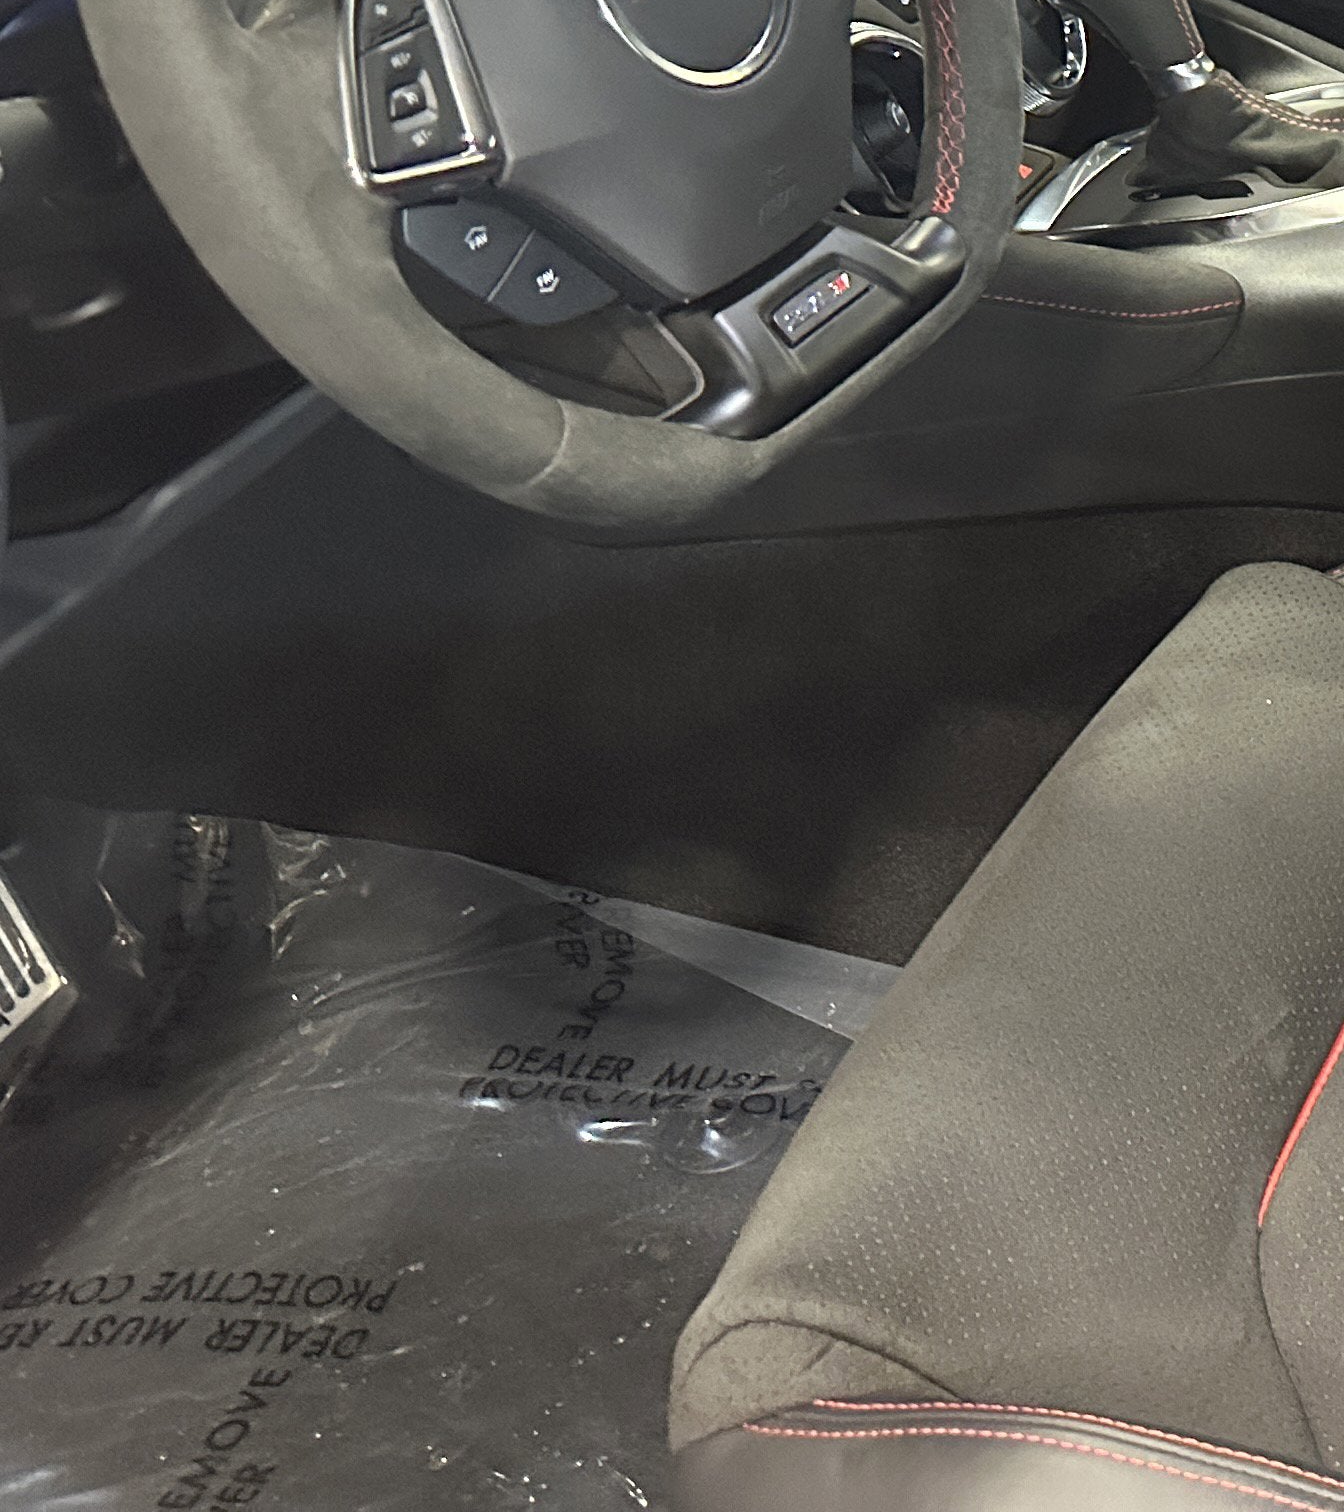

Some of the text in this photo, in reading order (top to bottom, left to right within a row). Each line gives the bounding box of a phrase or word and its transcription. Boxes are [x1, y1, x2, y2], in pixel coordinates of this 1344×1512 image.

[488, 1044, 635, 1083] DEALER
[653, 1061, 777, 1091] MUST
[140, 1270, 399, 1314] PROTECTIVE
[57, 1315, 190, 1347] MUST
[204, 1317, 370, 1359] DEALER
